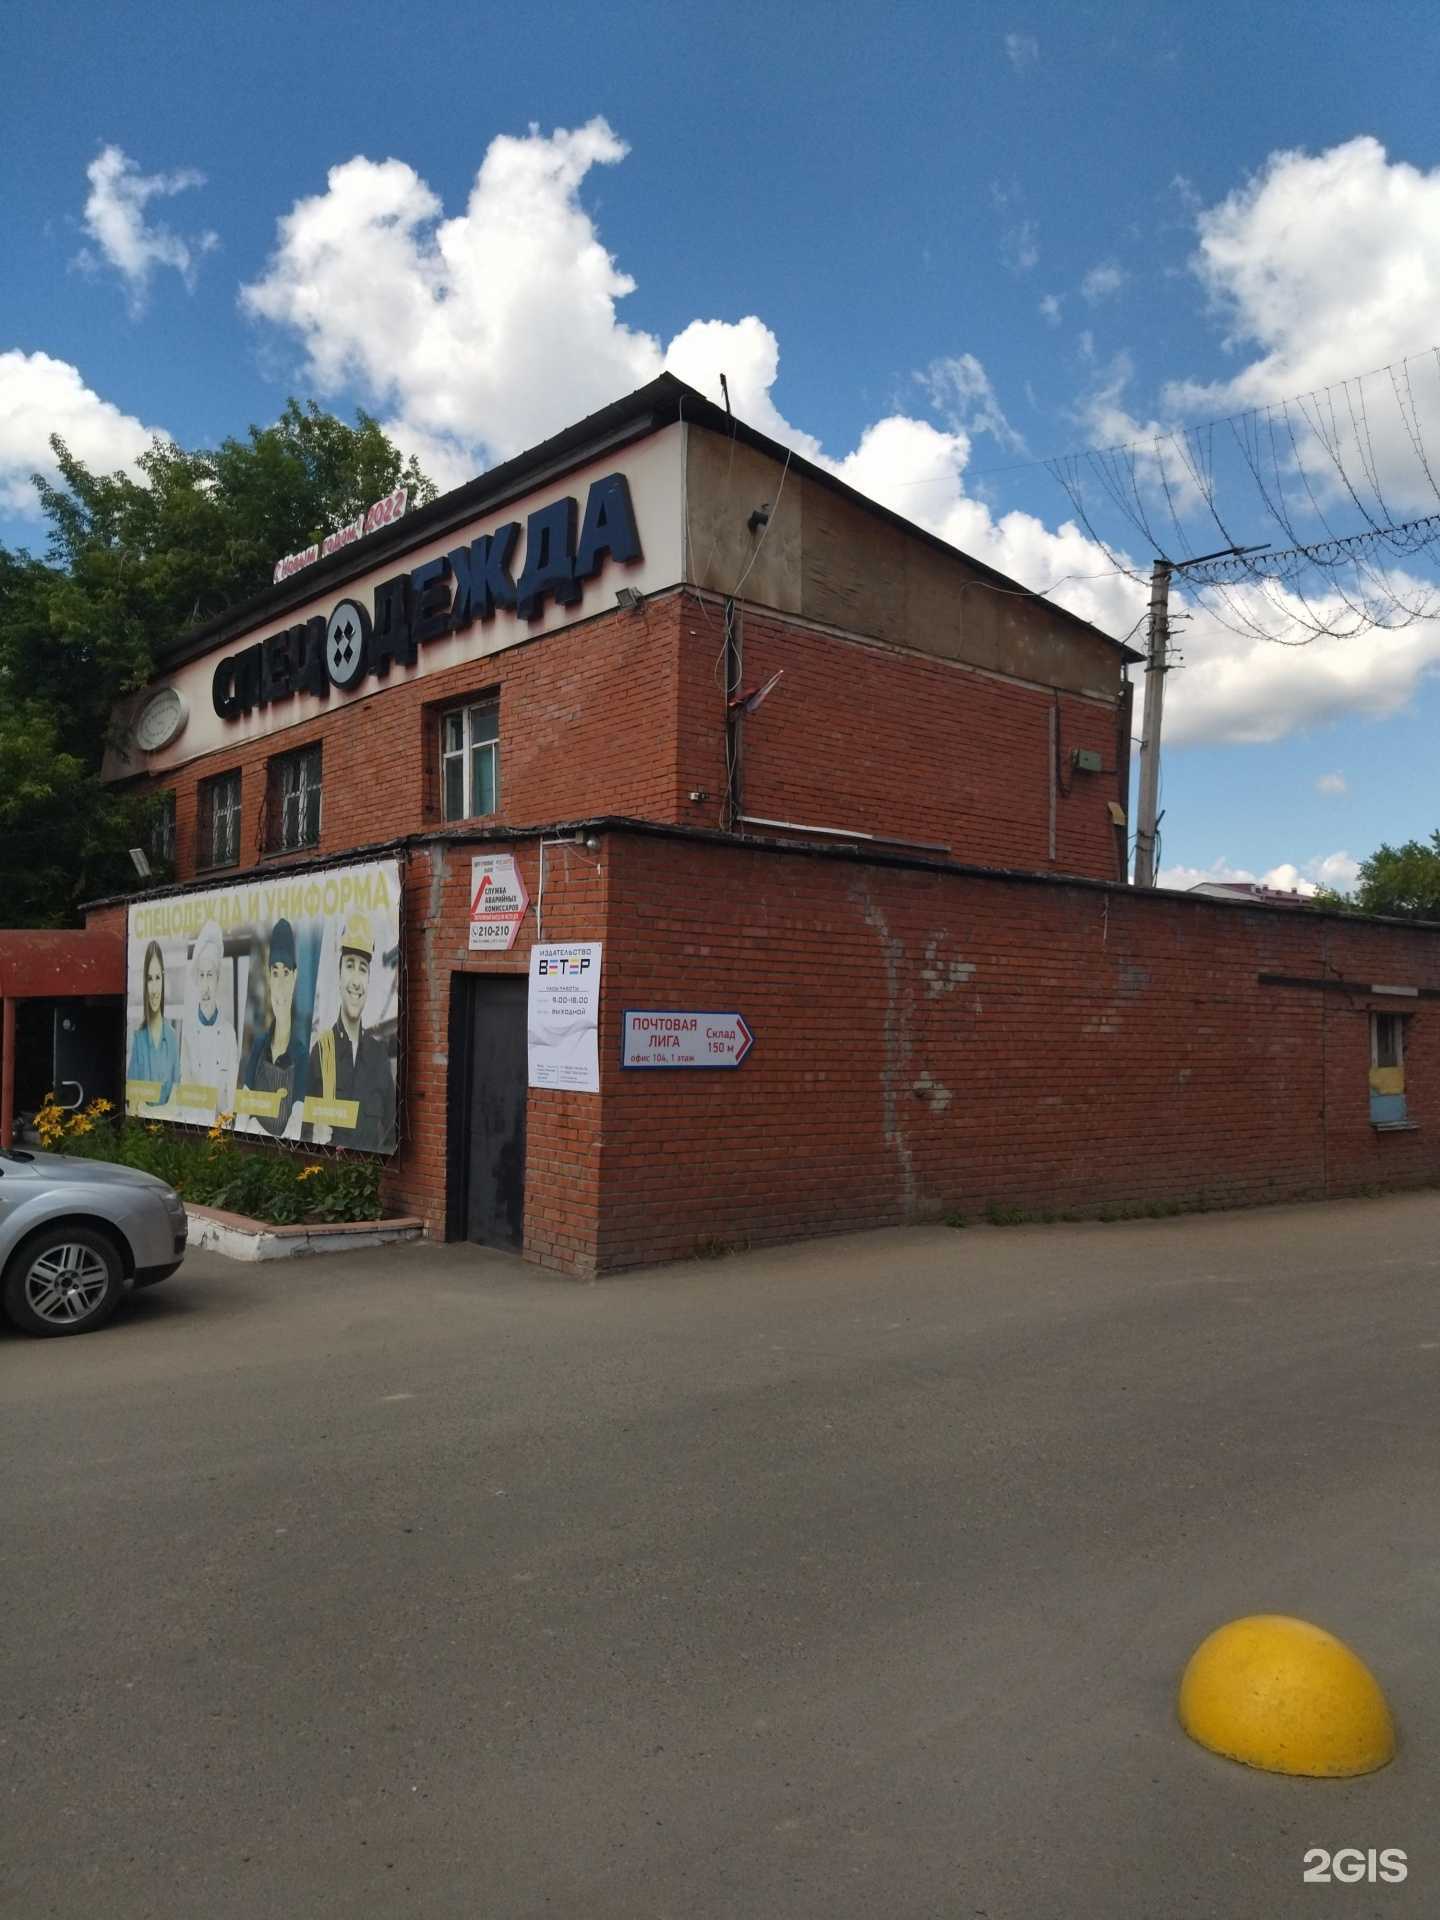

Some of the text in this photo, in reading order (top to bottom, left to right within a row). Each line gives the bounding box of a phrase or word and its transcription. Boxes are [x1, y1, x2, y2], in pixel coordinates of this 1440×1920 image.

[484, 886, 507, 895] СЛУЖБА
[133, 896, 242, 938] СПЕЦОДЕЖДА
[262, 870, 390, 921] УНИФОРМА
[484, 894, 517, 904] АВАРИЙНЫХ
[484, 904, 519, 913] КОМИССАРОВ
[478, 926, 510, 937] 210-210
[539, 948, 592, 957] ИЗДАТЕЛЬСТВО
[632, 1017, 697, 1031] ПОЧТОВАЯ
[706, 1028, 736, 1040] Склад
[648, 1035, 680, 1048] ЛИГА
[708, 1042, 725, 1053] 150
[630, 1054, 650, 1063] офис
